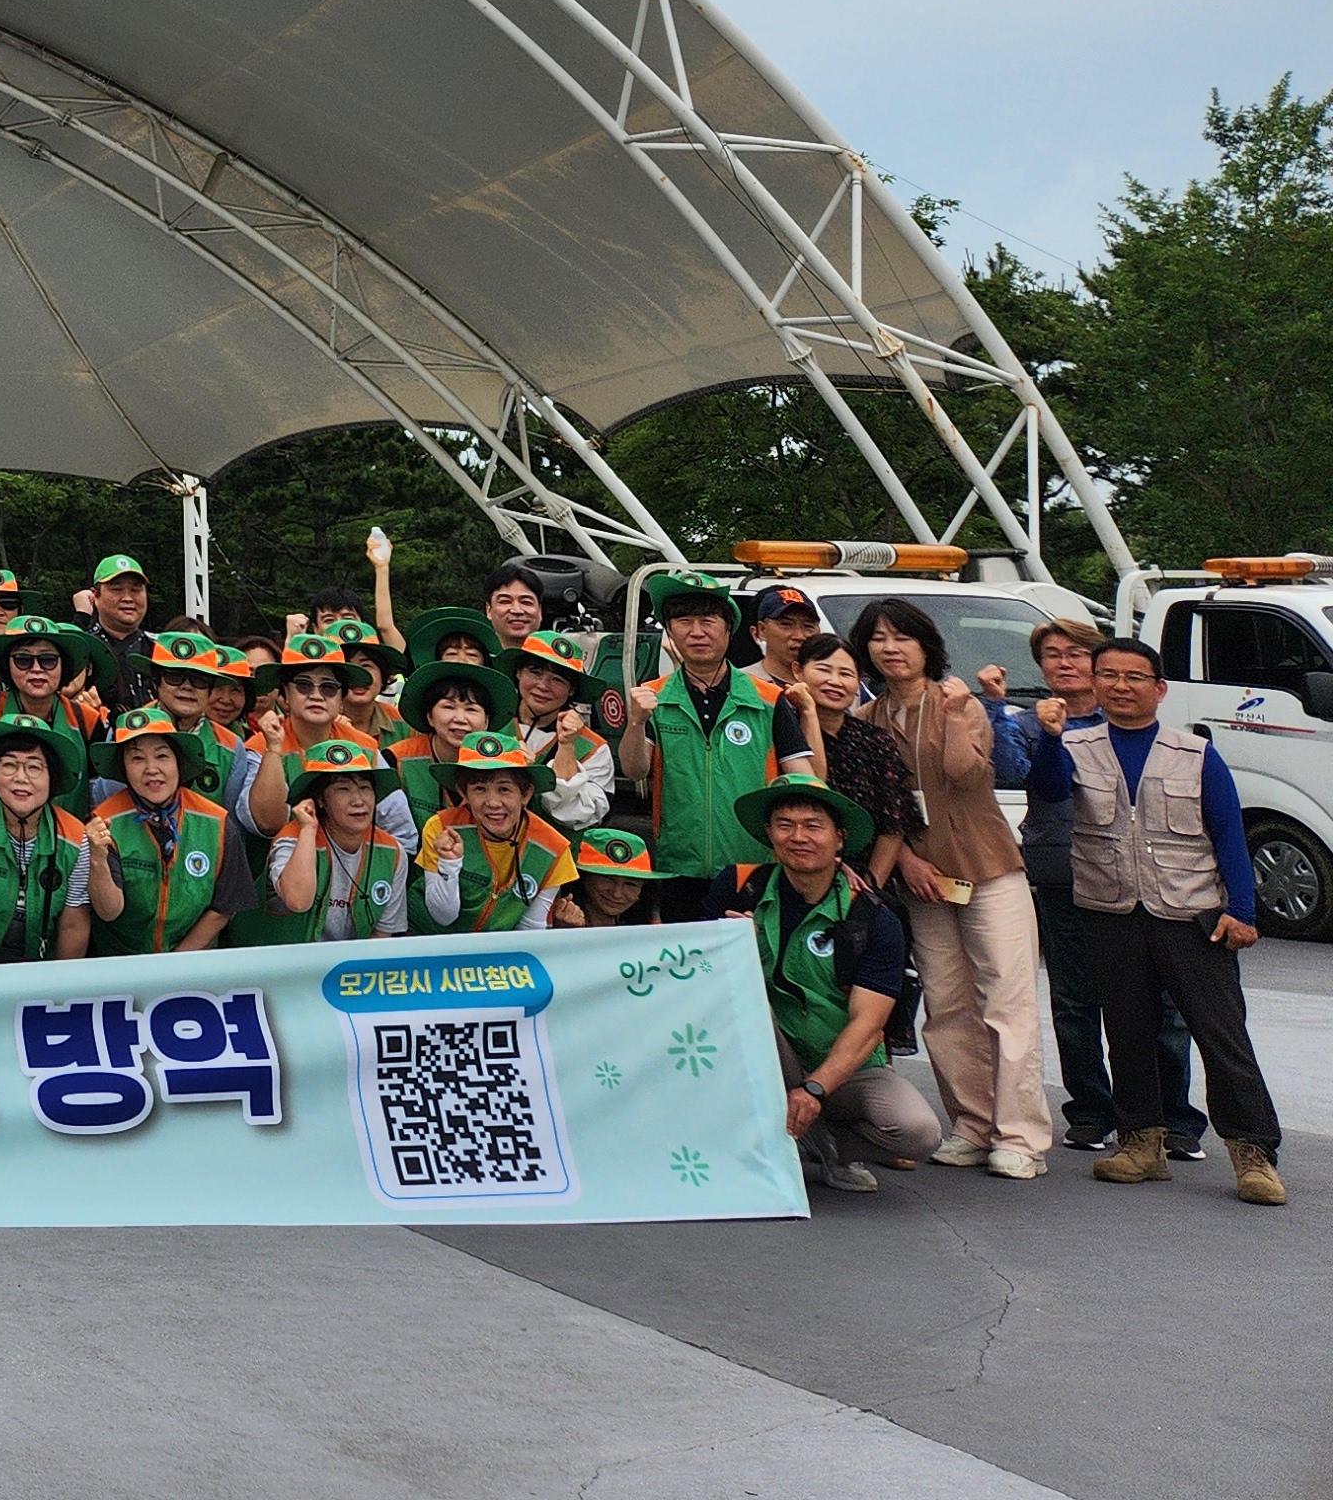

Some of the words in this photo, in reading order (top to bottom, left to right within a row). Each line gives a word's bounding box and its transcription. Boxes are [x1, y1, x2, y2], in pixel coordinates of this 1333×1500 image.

[1235, 712, 1265, 723] 안산시
[339, 970, 433, 997] 모기감시
[440, 964, 536, 994] 시민참여
[21, 993, 275, 1129] 방역
